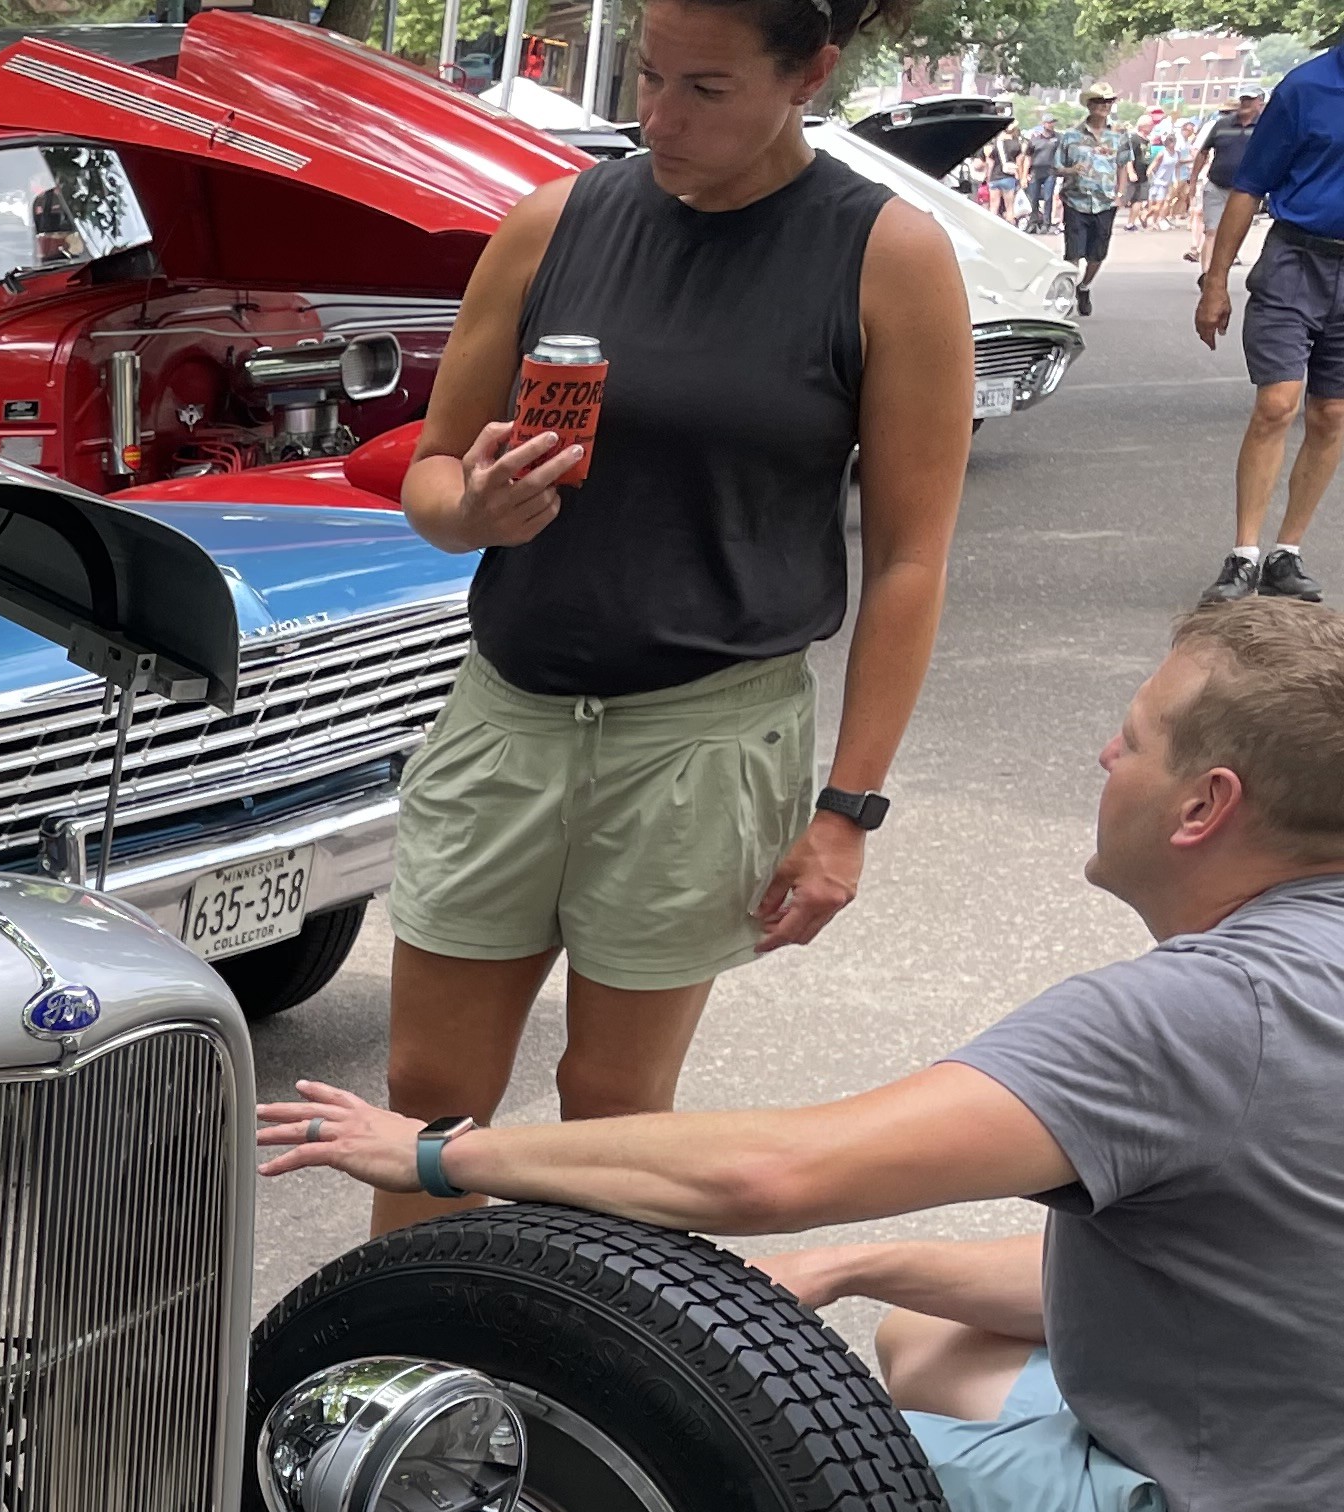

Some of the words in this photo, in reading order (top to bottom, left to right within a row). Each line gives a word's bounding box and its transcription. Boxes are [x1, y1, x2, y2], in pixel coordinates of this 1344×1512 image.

[521, 407, 592, 430] MORE
[223, 857, 285, 886] MINNESOTA
[192, 868, 305, 941] 635-358
[213, 924, 275, 951] COLLECTOR
[43, 992, 97, 1027] Ford
